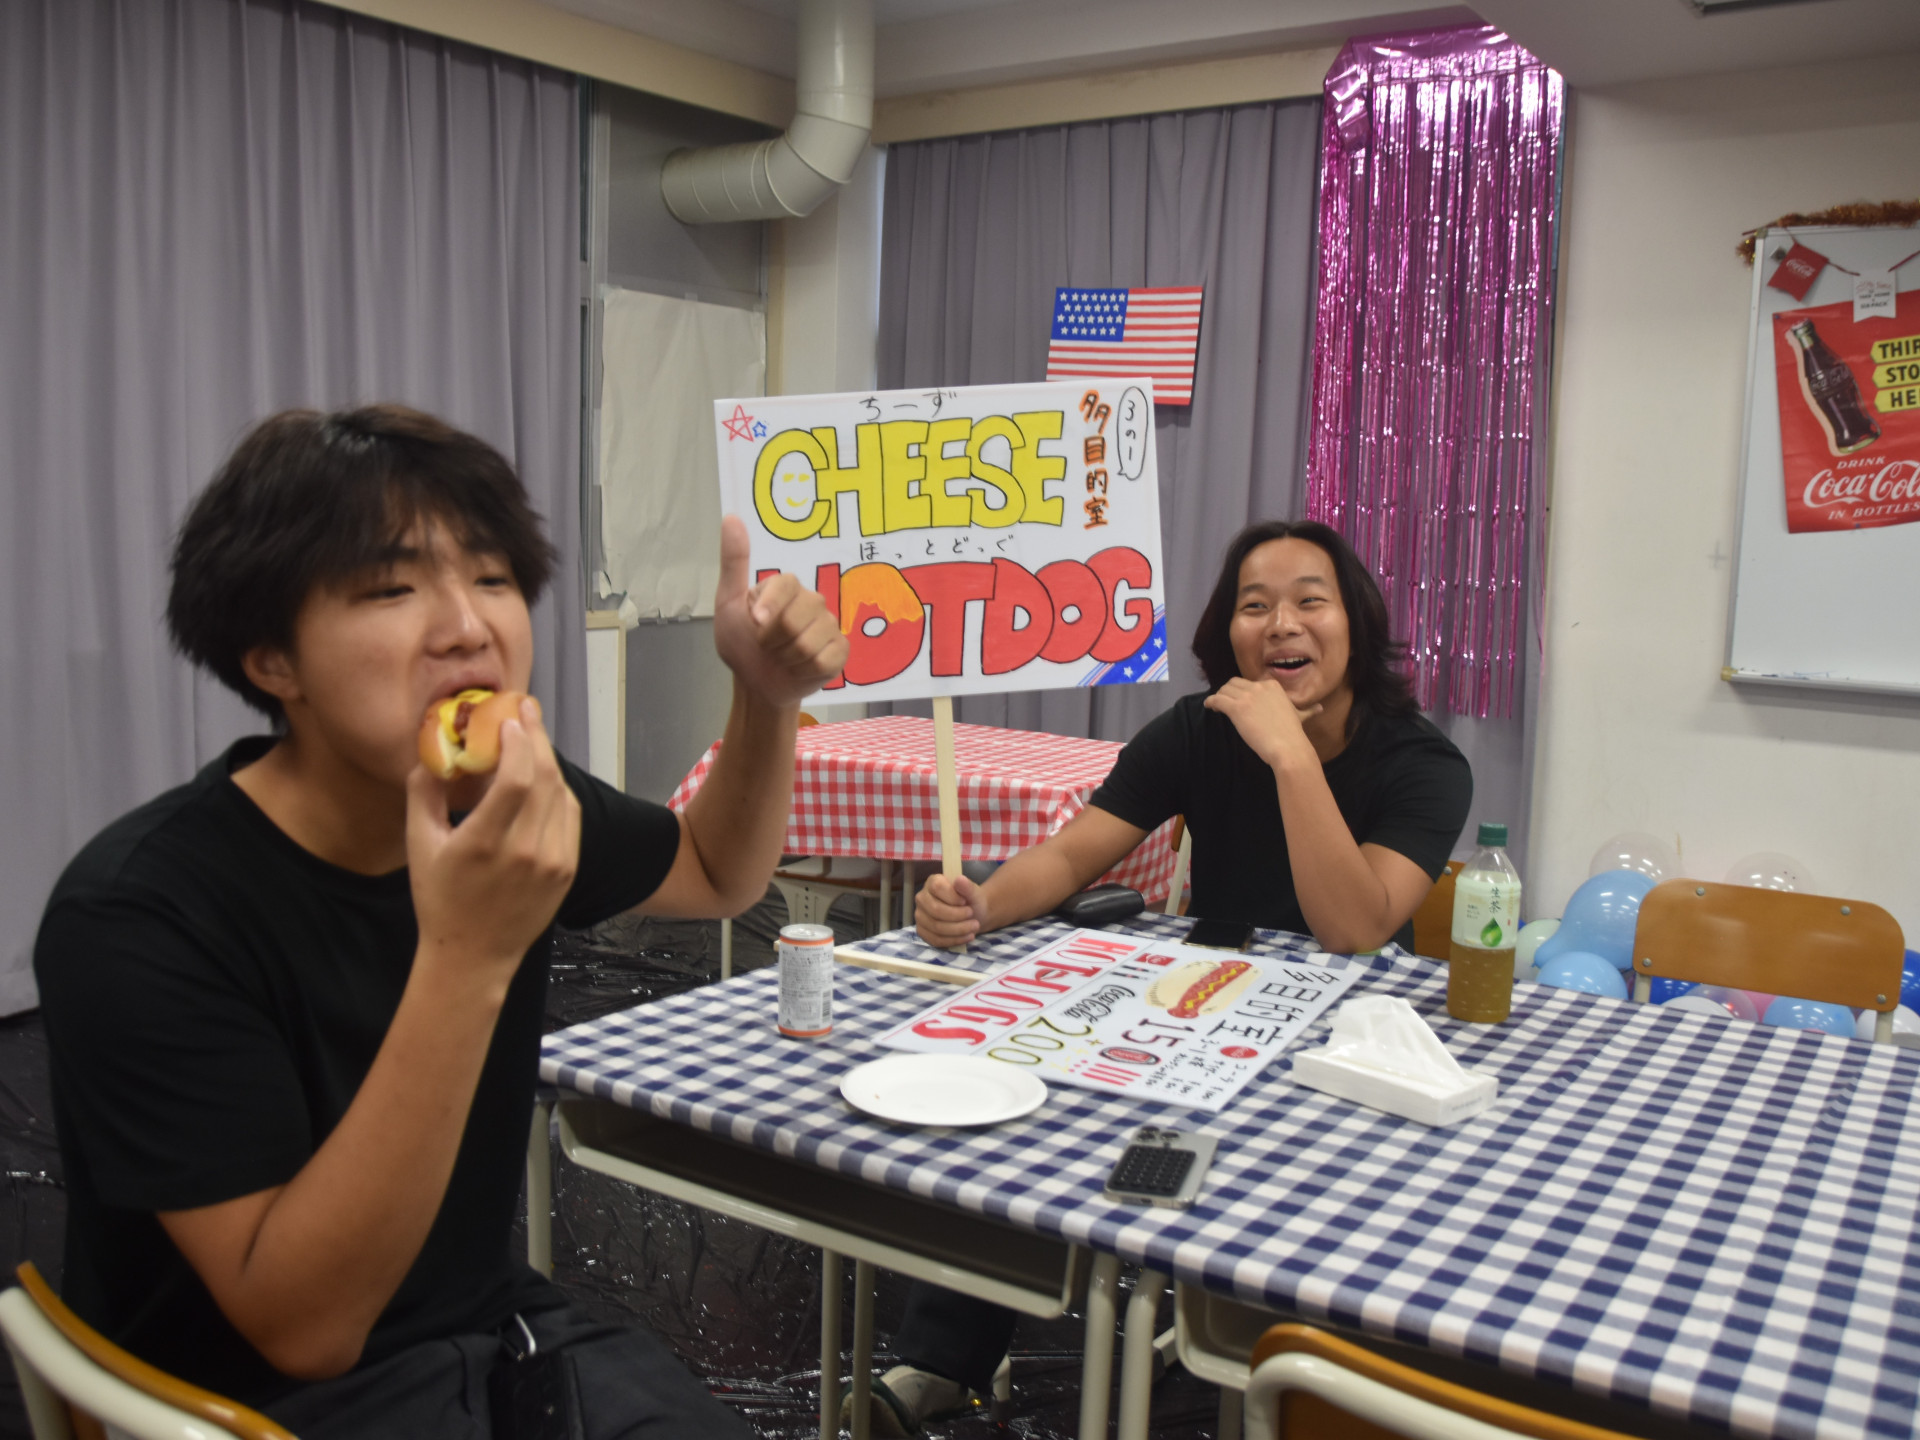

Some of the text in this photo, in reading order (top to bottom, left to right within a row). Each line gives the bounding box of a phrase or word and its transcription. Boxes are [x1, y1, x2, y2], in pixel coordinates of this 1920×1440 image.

[859, 388, 957, 422] ちーず
[1890, 389, 1920, 408] HE
[753, 410, 1066, 541] CHEESE
[1079, 390, 1112, 530] 多目的室
[1836, 456, 1886, 470] DRINK
[1828, 502, 1920, 520] IN BOTTLES
[1489, 886, 1501, 914] 生茶
[911, 937, 1137, 1046] HOT DOGS
[1206, 968, 1340, 1045] 多目的室
[987, 1015, 1093, 1065] 200
